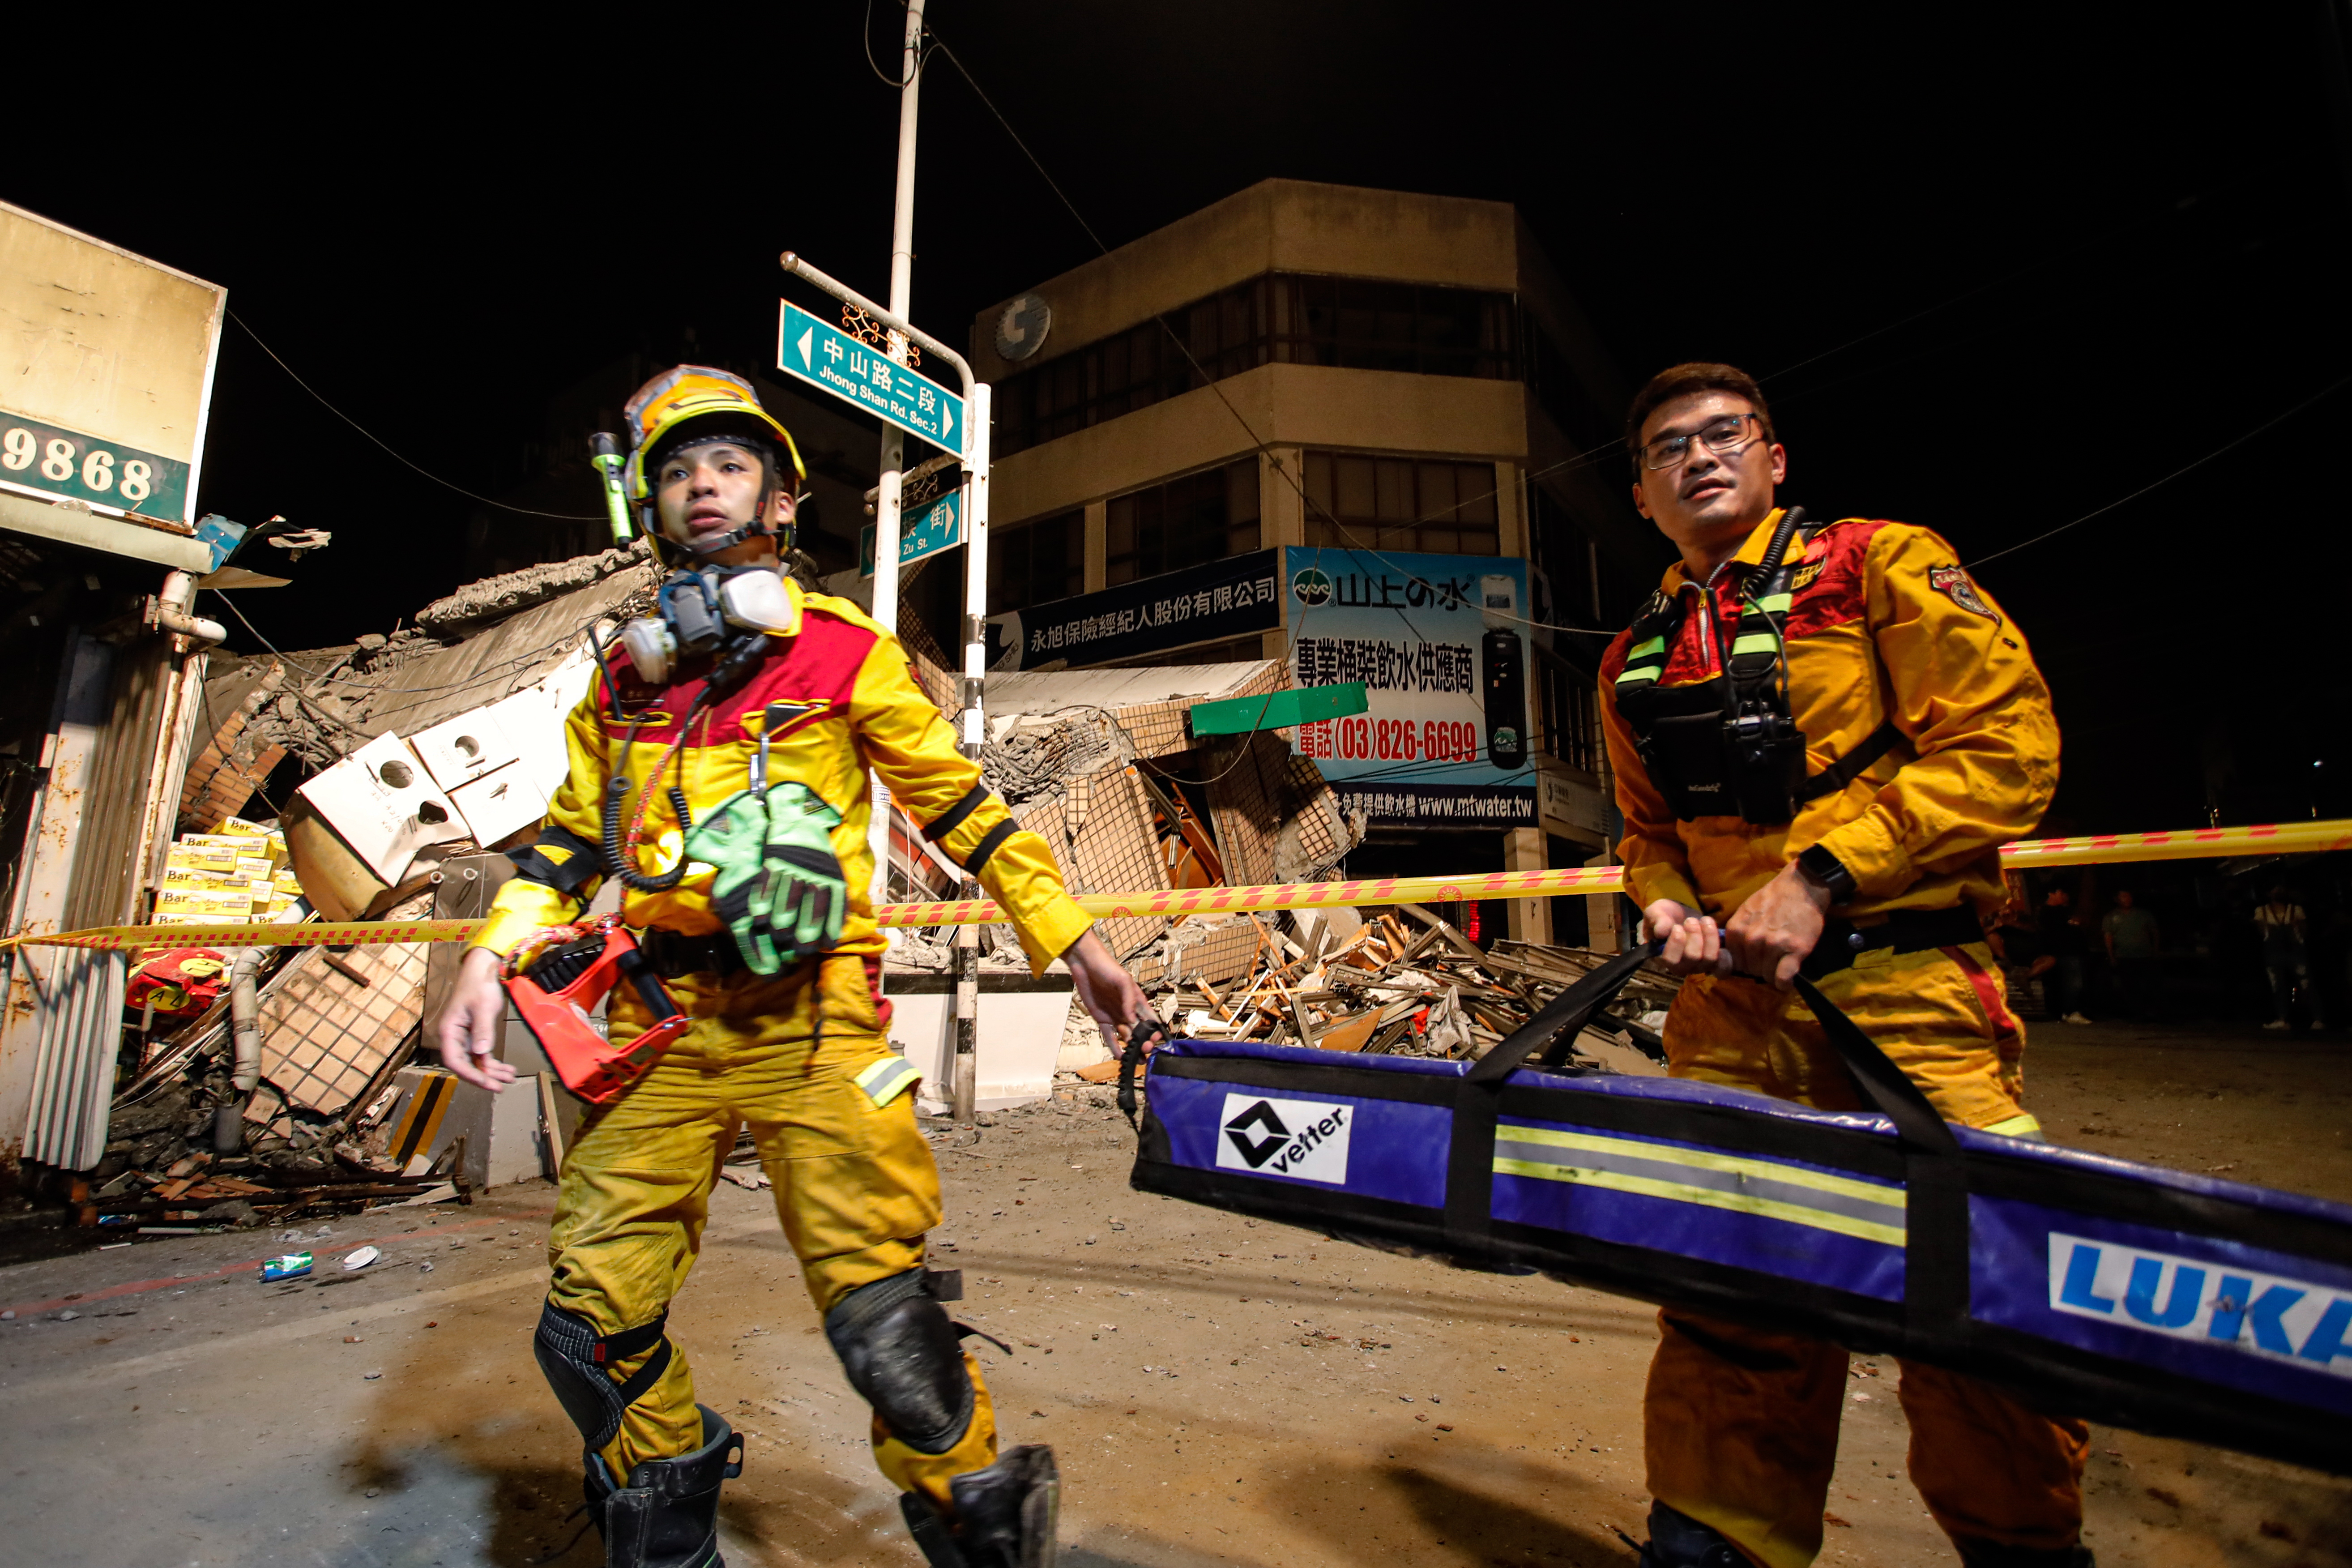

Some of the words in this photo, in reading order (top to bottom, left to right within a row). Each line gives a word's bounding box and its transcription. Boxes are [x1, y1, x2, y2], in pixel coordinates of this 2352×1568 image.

[824, 337, 936, 415] 中山路二段
[820, 365, 857, 396] Jhong
[859, 385, 888, 410] Shan
[890, 400, 908, 419] Rd.
[909, 410, 937, 435] Sec.2
[1, 428, 152, 501] 9868
[903, 543, 914, 555] Zu
[917, 538, 928, 550] St.
[1336, 573, 1472, 611] 山上の水
[1031, 576, 1275, 652] 永旭保險經紀人股份有限公司
[1297, 637, 1473, 694] 專業桶裝飲水供應商
[1418, 794, 1532, 818] www.mtwater.tw
[187, 837, 209, 846] Bar
[231, 820, 251, 831] Bar
[167, 870, 191, 880] Bar
[163, 893, 188, 902] Bar
[1270, 1107, 1343, 1174] vetter
